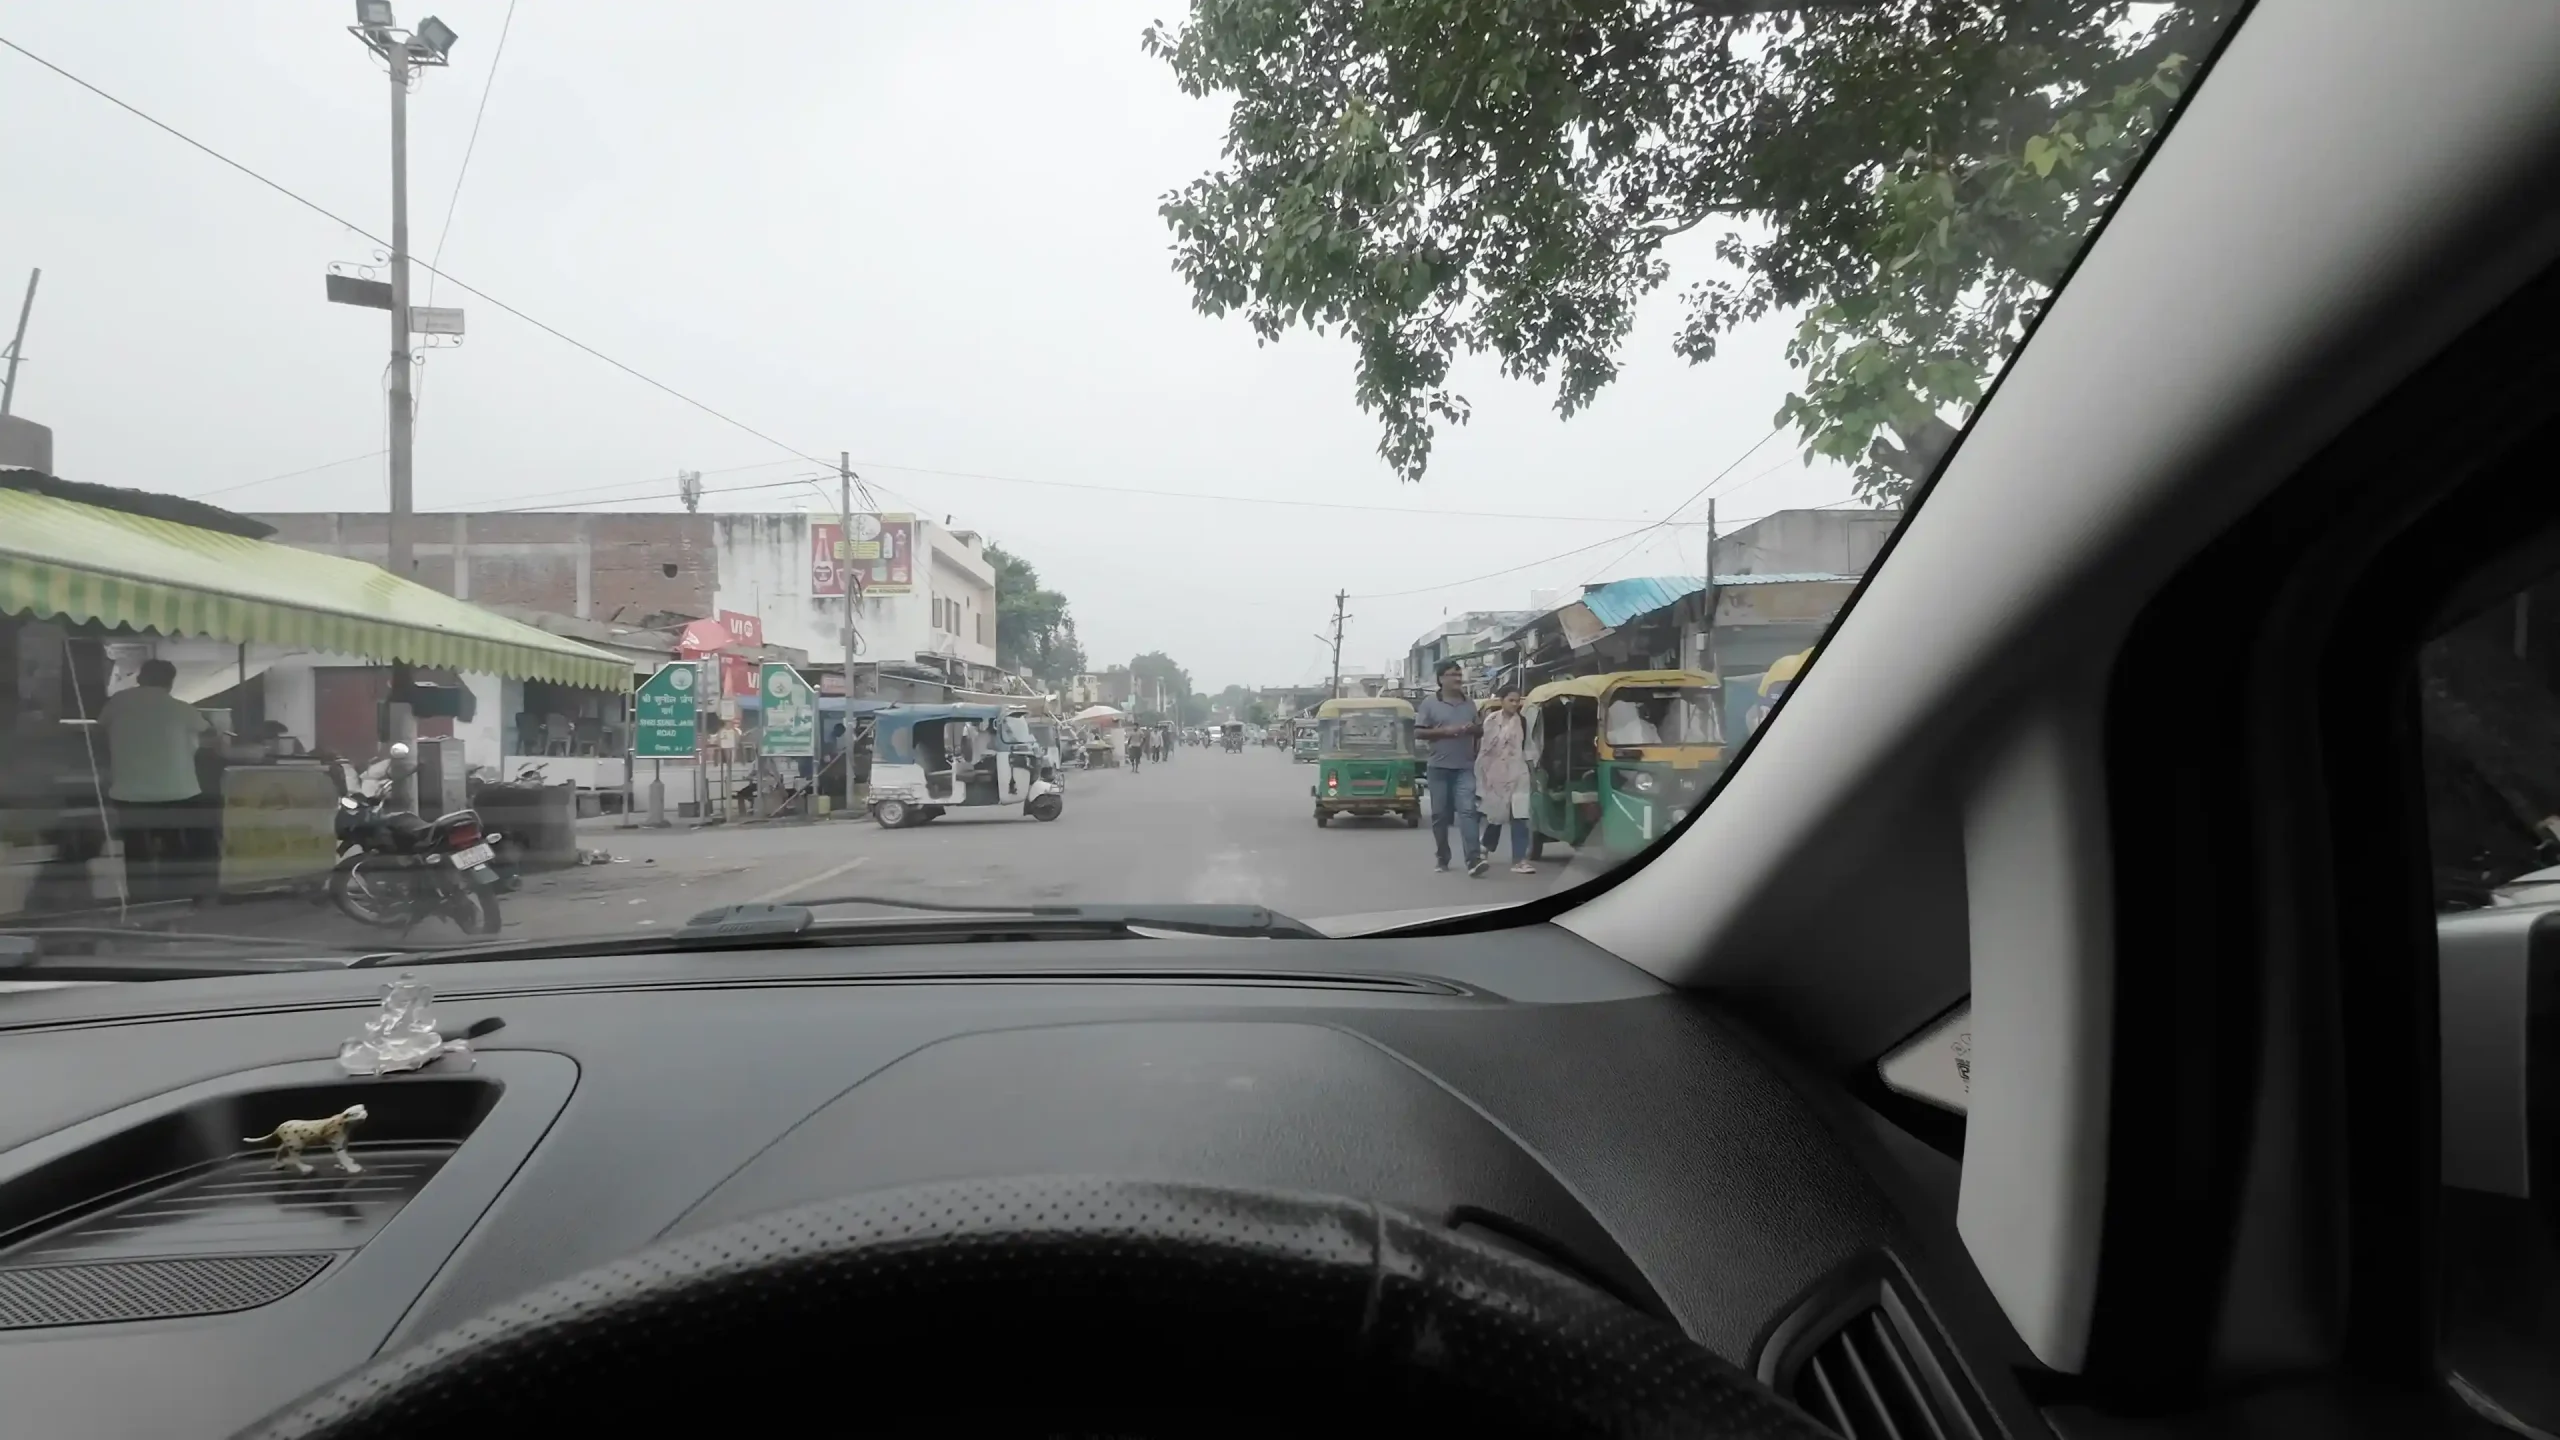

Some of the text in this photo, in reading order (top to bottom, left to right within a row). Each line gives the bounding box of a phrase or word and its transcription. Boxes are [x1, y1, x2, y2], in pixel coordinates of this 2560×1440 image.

[640, 719, 656, 727] SHRI
[657, 719, 677, 727] SUNIL
[656, 729, 677, 737] ROAD
